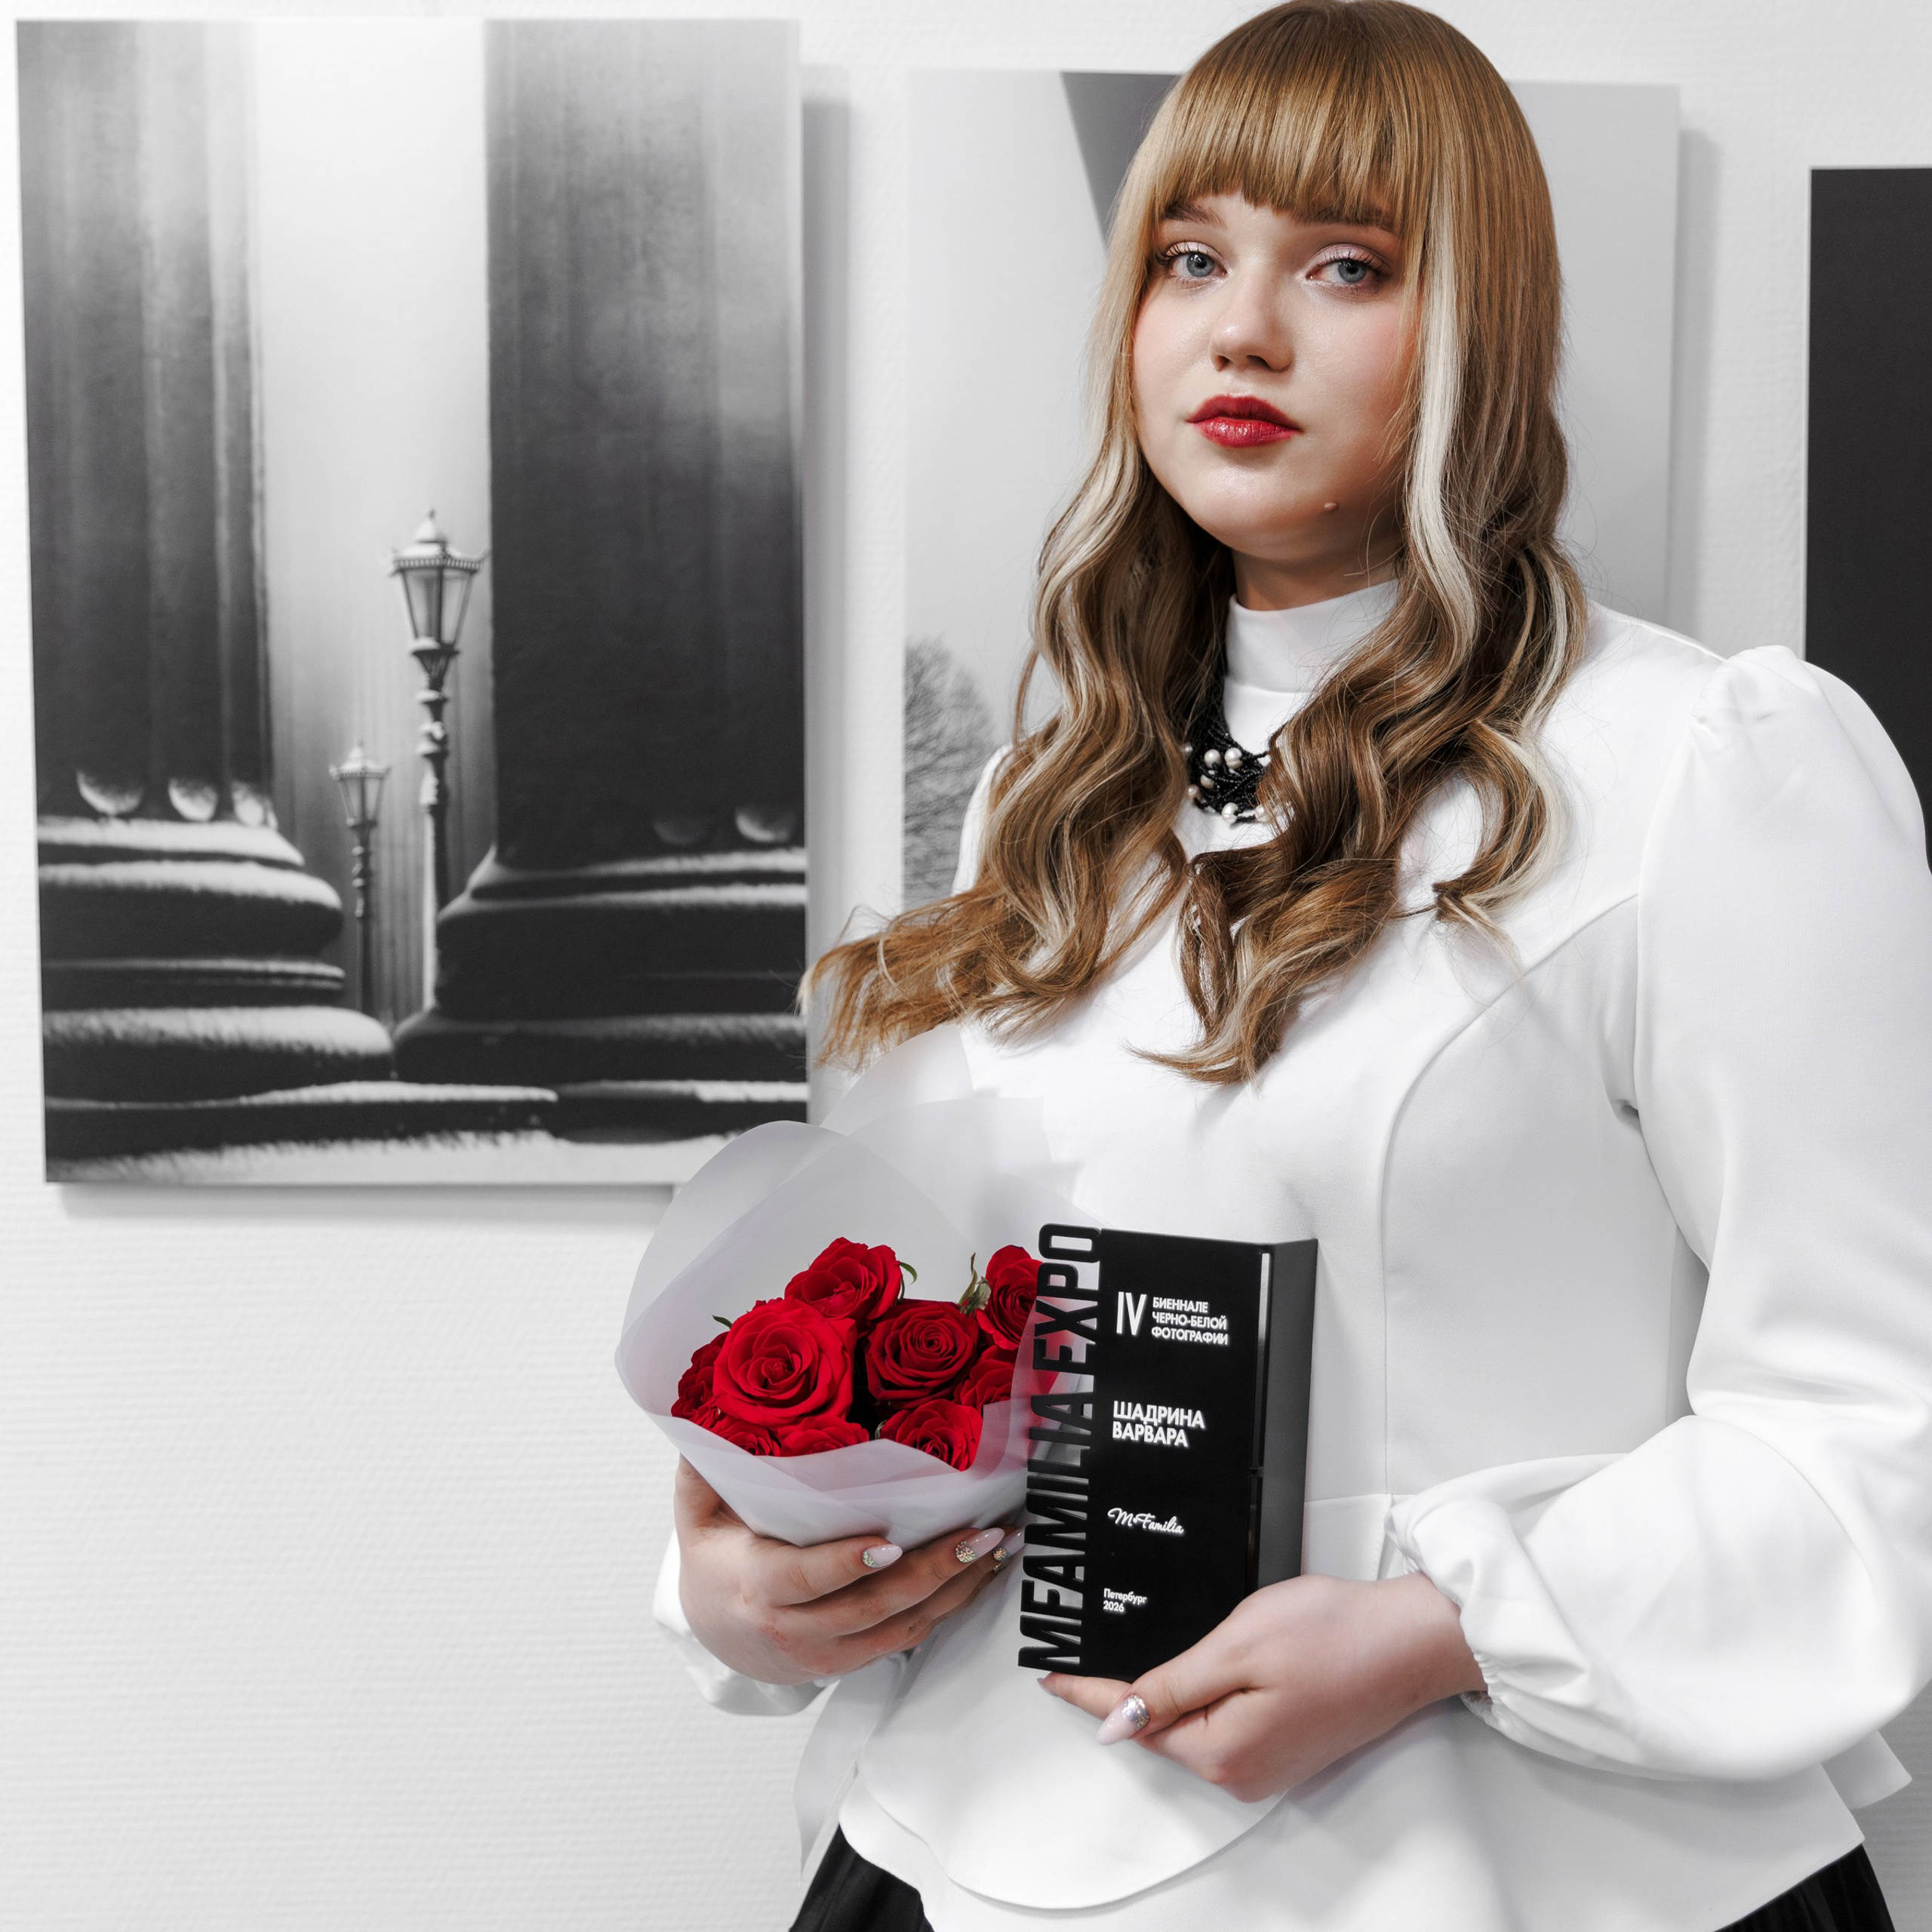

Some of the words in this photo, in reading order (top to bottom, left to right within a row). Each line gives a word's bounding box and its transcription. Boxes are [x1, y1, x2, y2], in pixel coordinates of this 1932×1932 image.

[1032, 1223, 1102, 1375] EXPO
[1152, 1297, 1209, 1314] БИЕННАЛЕ
[1116, 1291, 1147, 1335] IV
[1152, 1312, 1227, 1331] ЧЕРНО-БЕЛОЙ
[1151, 1326, 1229, 1346] ФОТОГРАФИИ
[1113, 1401, 1205, 1429] ШАДРИНА
[1112, 1420, 1189, 1447] ВАРВАРА
[1017, 1390, 1094, 1667] MFAMILIA
[1103, 1588, 1148, 1606] Петербург
[1103, 1600, 1125, 1613] 2026
